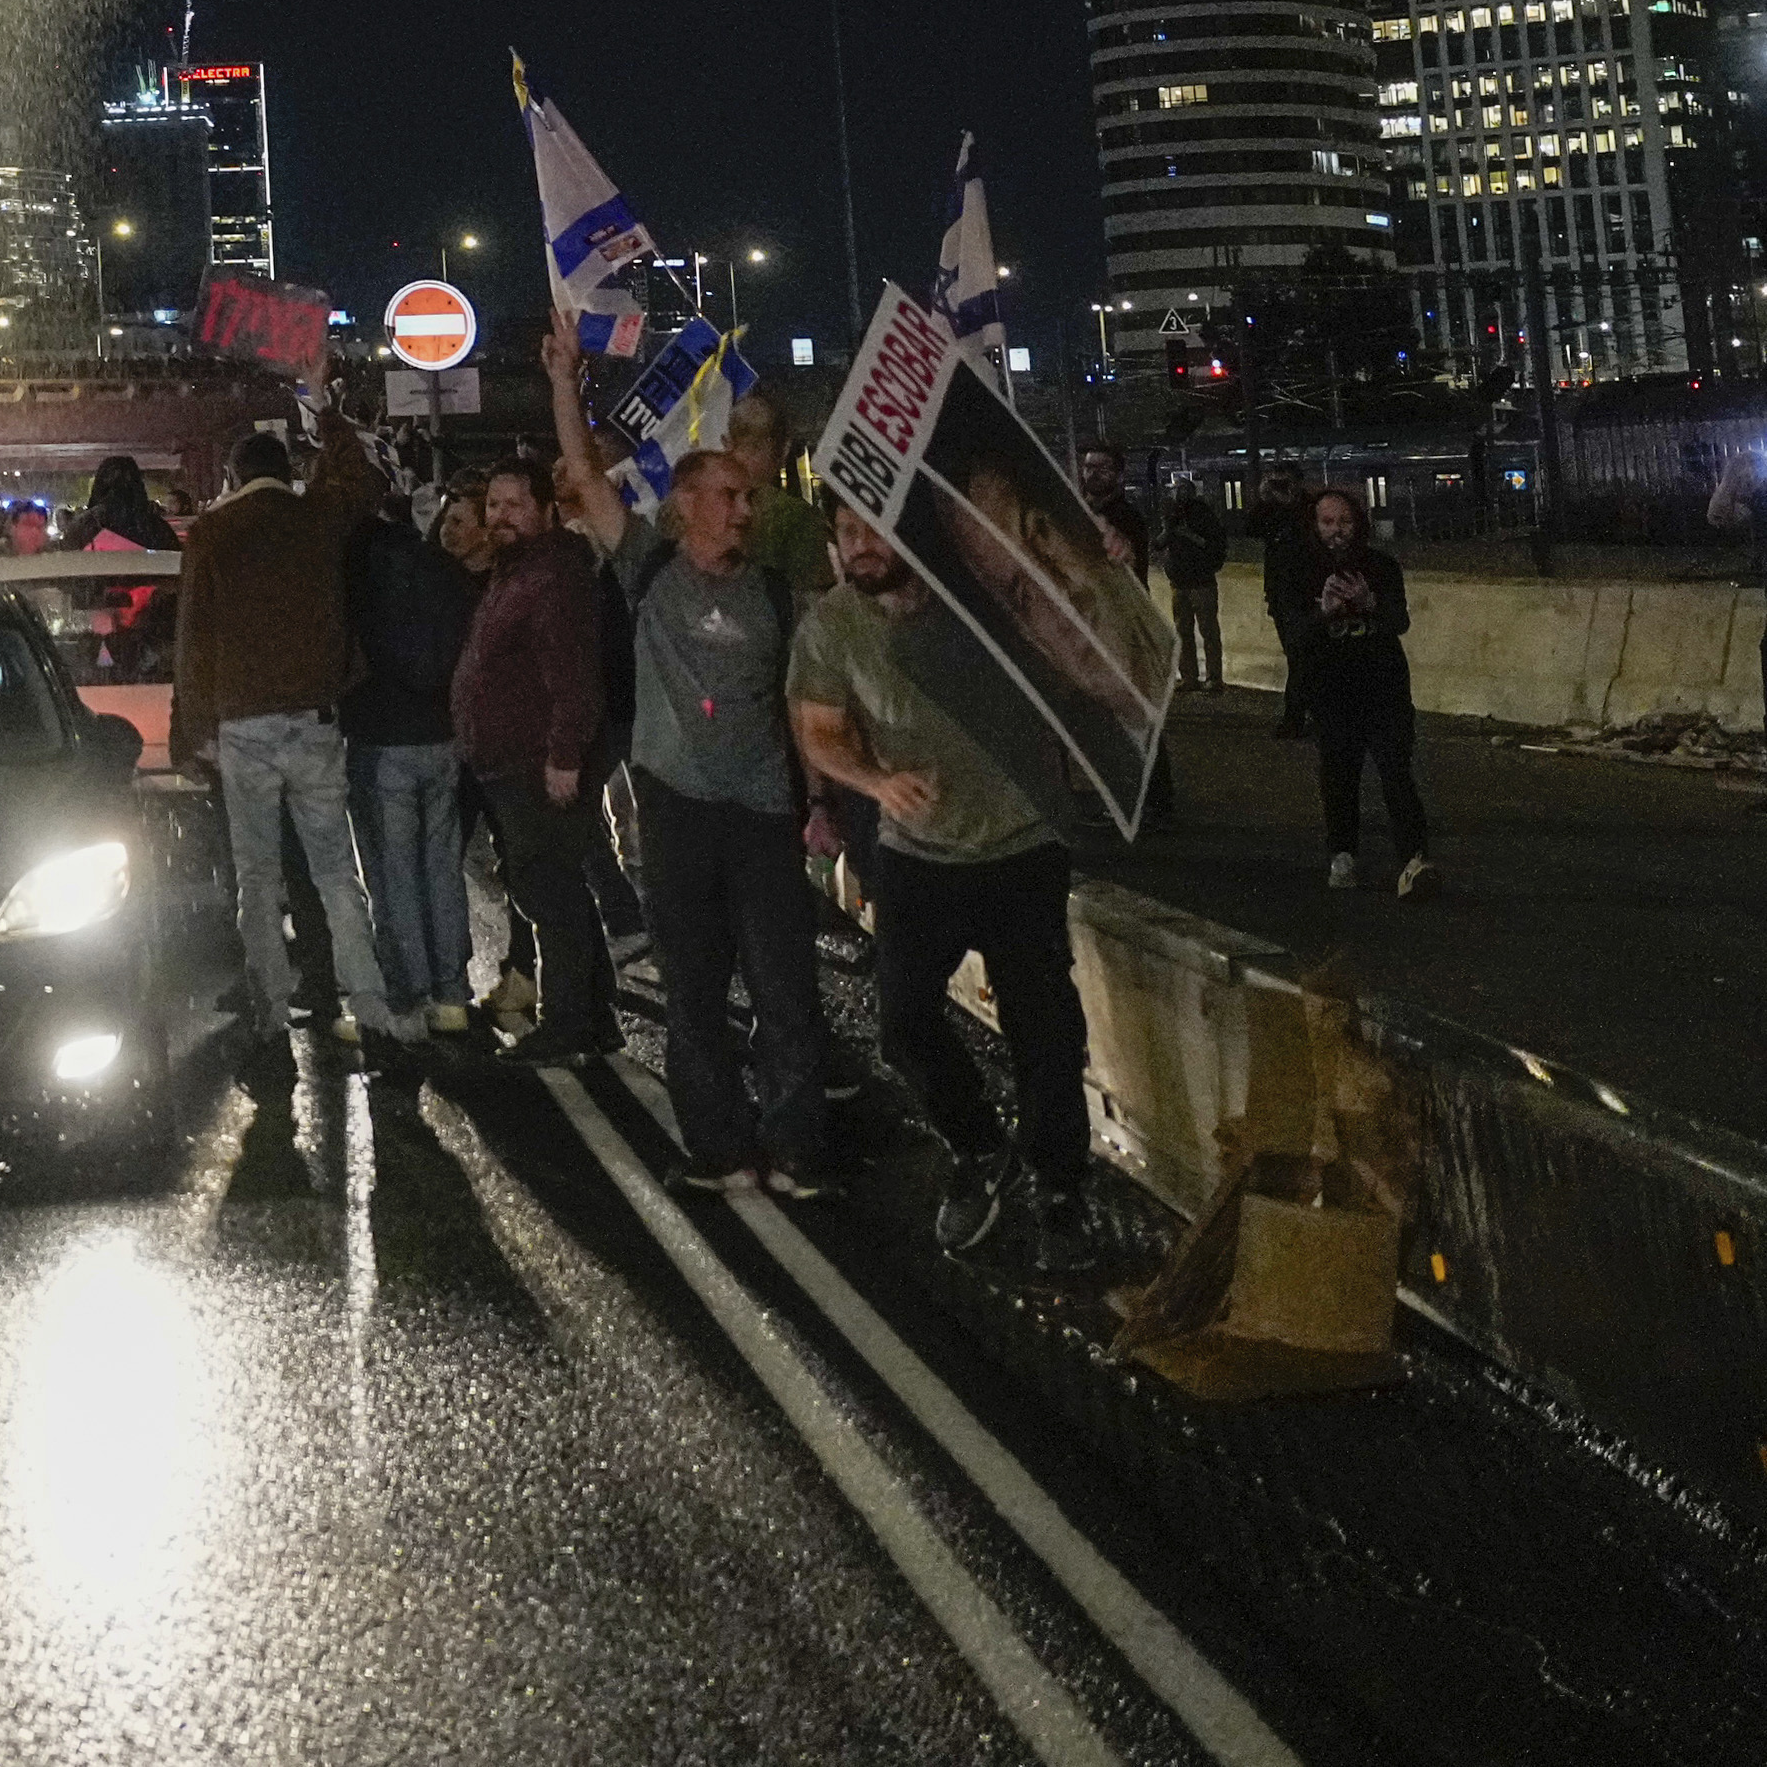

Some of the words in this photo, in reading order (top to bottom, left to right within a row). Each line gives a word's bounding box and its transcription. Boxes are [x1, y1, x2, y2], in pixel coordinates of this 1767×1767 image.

[1169, 316, 1177, 331] 3
[856, 300, 948, 455] ESCOBAR
[830, 421, 901, 517] BIBI
